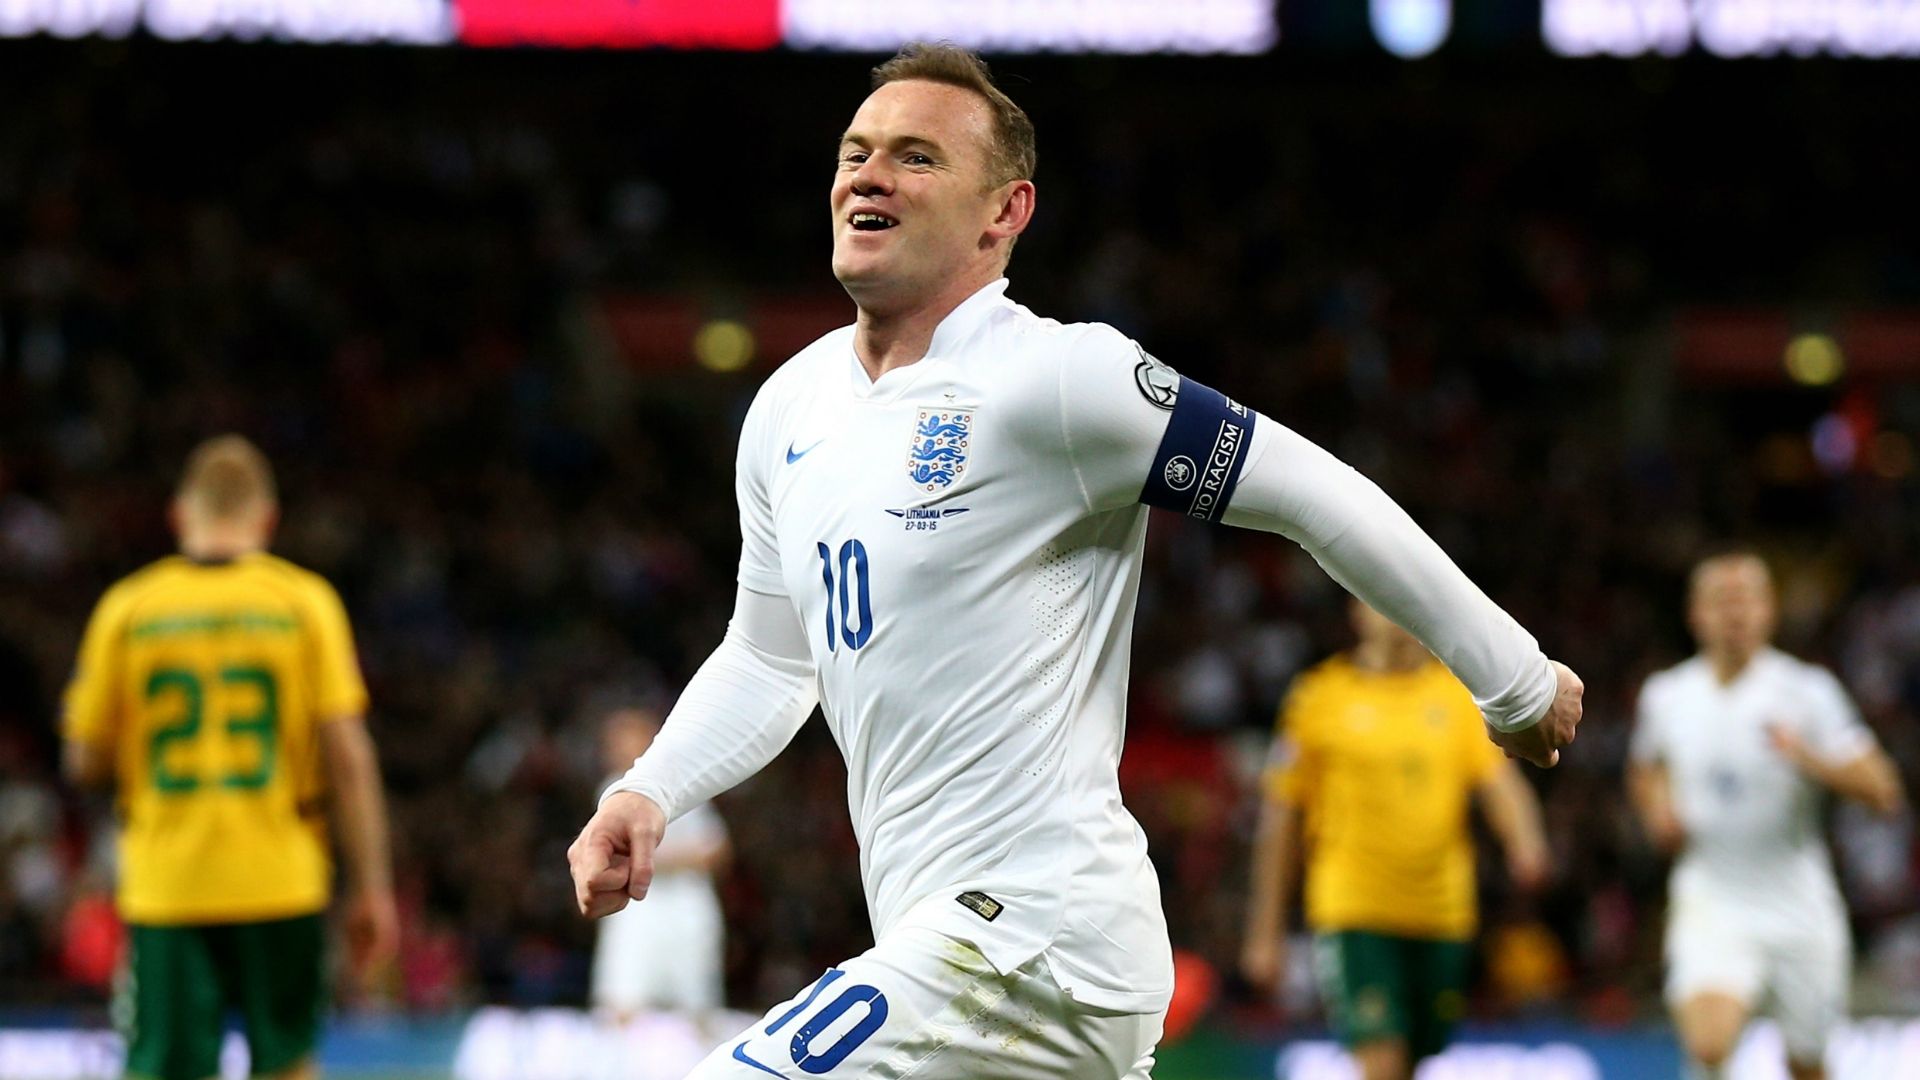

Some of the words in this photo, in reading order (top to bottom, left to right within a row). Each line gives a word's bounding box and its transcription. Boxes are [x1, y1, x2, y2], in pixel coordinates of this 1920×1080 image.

[906, 509, 941, 519] LITHUANIA
[1195, 493, 1213, 511] TO
[1205, 423, 1239, 491] RACISM
[817, 538, 873, 652] 10
[144, 666, 278, 791] 23
[764, 969, 888, 1074] 10
